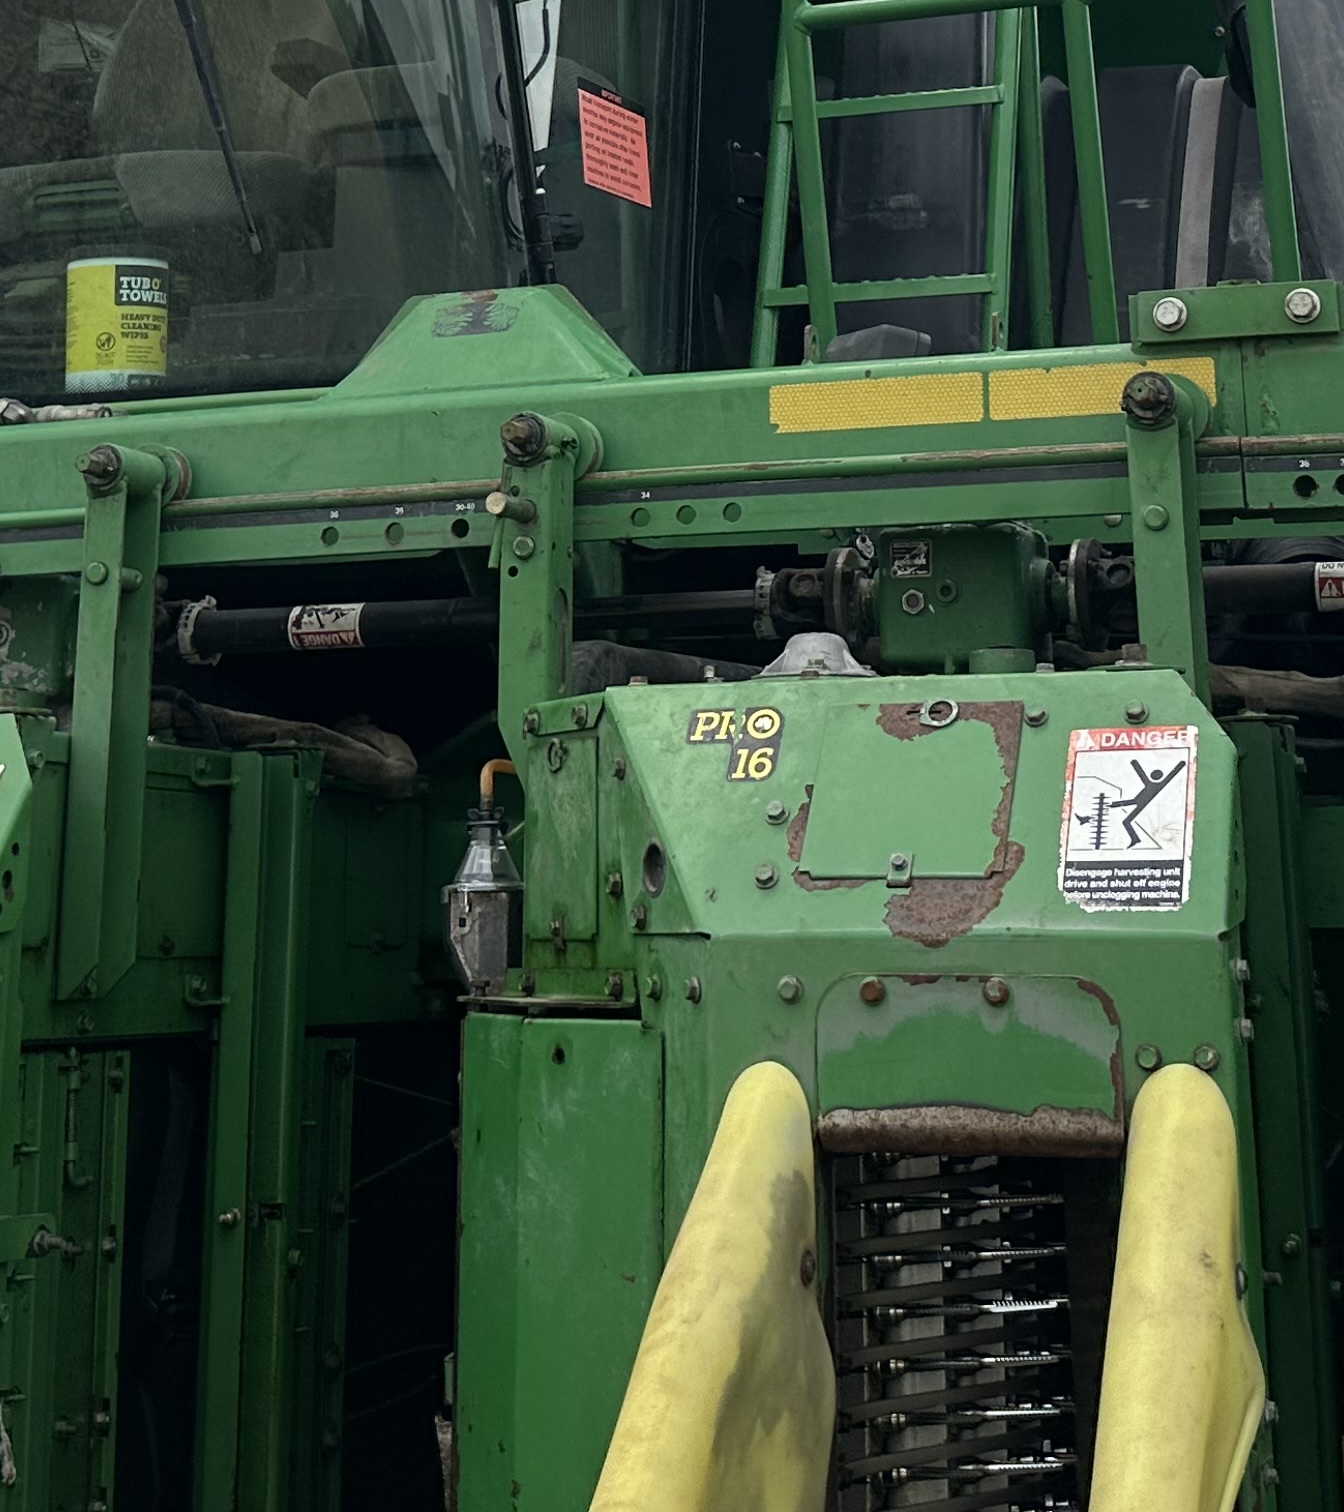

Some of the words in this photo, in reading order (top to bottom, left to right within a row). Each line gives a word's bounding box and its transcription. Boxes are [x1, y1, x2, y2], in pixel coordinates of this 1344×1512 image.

[119, 276, 151, 290] TUB
[640, 491, 651, 499] 34
[1101, 730, 1190, 747] DANGER
[731, 747, 774, 780] 16
[1065, 868, 1113, 879] Disengage
[1114, 867, 1161, 879] harvesting
[1163, 867, 1181, 877] unit
[1064, 879, 1088, 889] drive
[1089, 879, 1108, 888] and
[1109, 879, 1132, 888] shut
[1133, 879, 1147, 888] off
[1147, 878, 1181, 888] engine
[1092, 890, 1141, 901] unclogging
